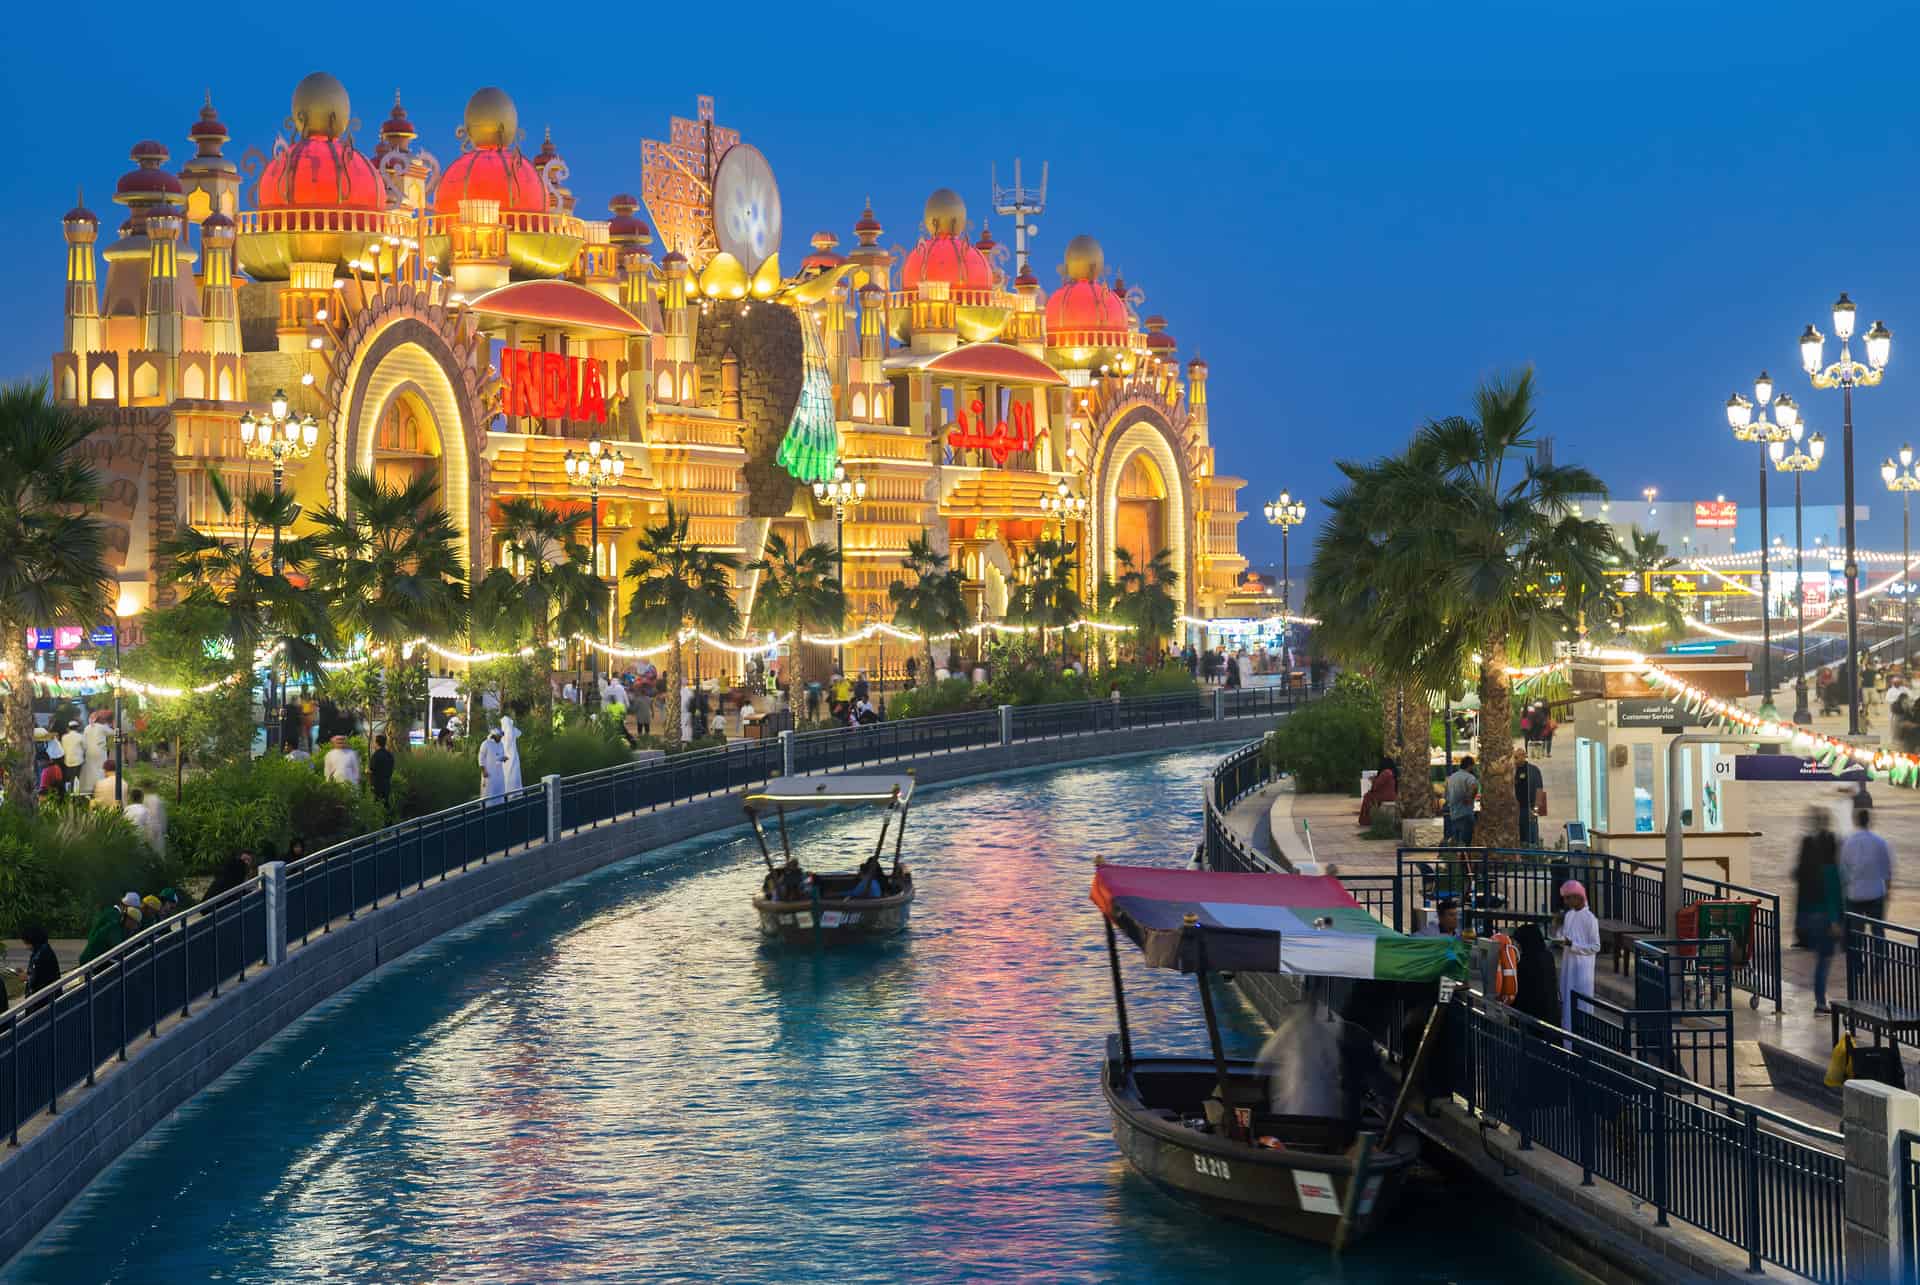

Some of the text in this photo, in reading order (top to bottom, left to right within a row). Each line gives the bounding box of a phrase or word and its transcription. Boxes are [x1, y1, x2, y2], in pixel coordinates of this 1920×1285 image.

[501, 347, 607, 424] INDIA
[948, 399, 1035, 465] الهند
[1715, 762, 1730, 774] 01
